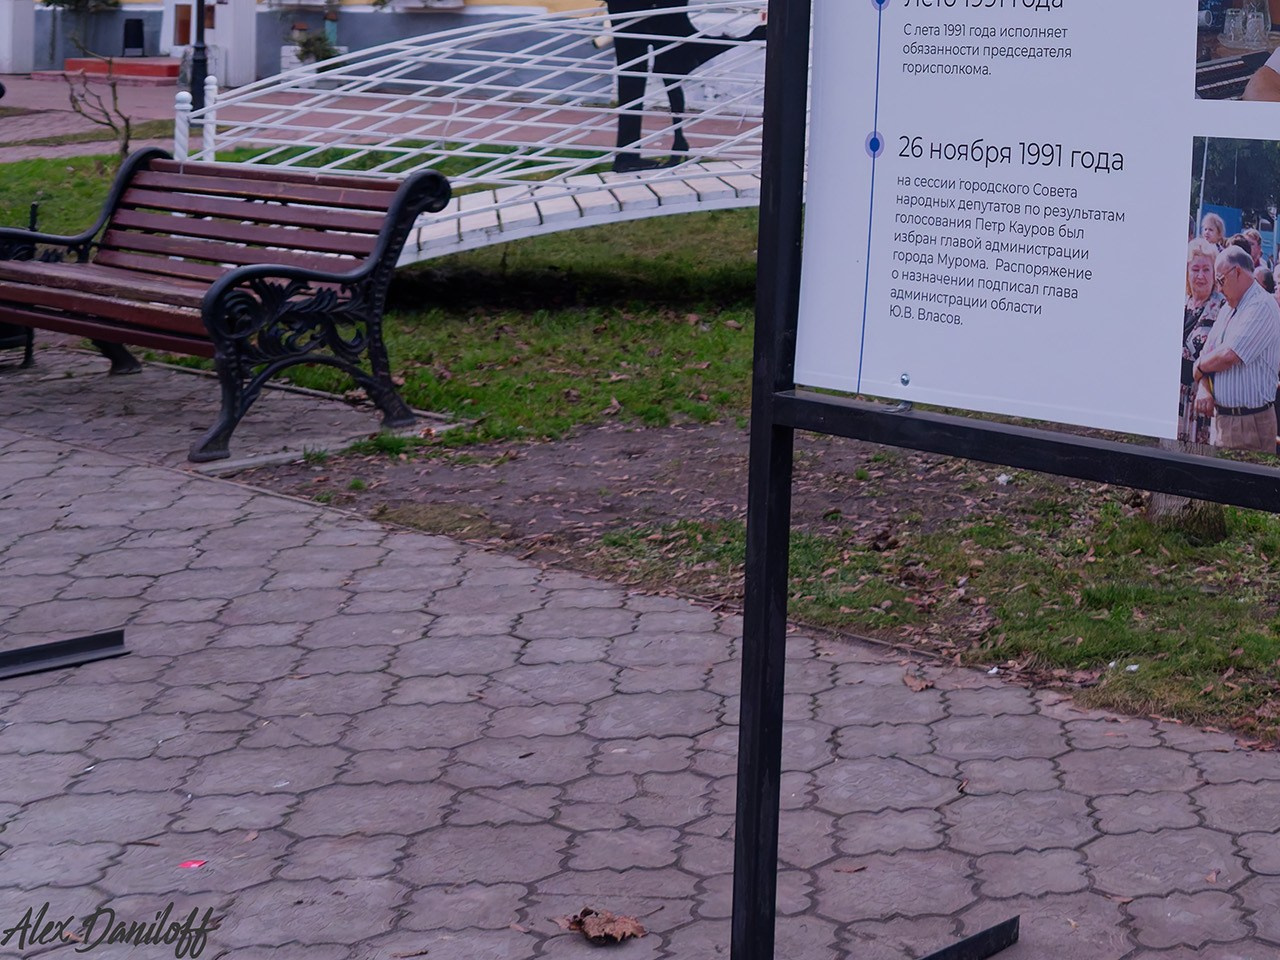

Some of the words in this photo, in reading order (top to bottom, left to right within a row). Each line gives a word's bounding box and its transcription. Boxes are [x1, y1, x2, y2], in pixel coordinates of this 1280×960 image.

[903, 22, 912, 36] С
[913, 25, 941, 37] лета
[943, 23, 966, 37] 1991
[969, 26, 997, 39] года
[999, 27, 1069, 39] исполняет
[902, 41, 980, 56] обязанности
[982, 46, 1072, 60] председателя
[902, 62, 992, 76] горисполкома.
[898, 135, 924, 159] 26
[930, 139, 1011, 168] ноября
[1018, 142, 1062, 167] 1991
[1070, 150, 1124, 174] года
[897, 176, 912, 187] на
[913, 176, 956, 190] сессии
[959, 180, 1030, 196] городского
[1032, 182, 1078, 199] Совета
[896, 194, 956, 209] народных
[957, 199, 1021, 215] депутатов
[1024, 204, 1041, 216] по
[1043, 206, 1125, 223] результатам
[895, 213, 972, 230] голосования
[975, 217, 1006, 234] Петр
[1009, 220, 1055, 238] Кауров
[1058, 224, 1085, 240] был
[894, 230, 937, 247] избран
[940, 236, 982, 250] главой
[984, 240, 1089, 261] администрации
[892, 250, 934, 266] города
[937, 252, 989, 270] Мурома.
[995, 258, 1093, 281] Распоряжение
[891, 269, 900, 280] о
[901, 270, 975, 288] назначении
[977, 278, 1039, 295] подписал
[1042, 285, 1079, 299] глава
[889, 304, 915, 320] Ю.В.
[917, 308, 963, 326] Власов.
[890, 288, 988, 309] администрации
[990, 297, 1042, 315] области
